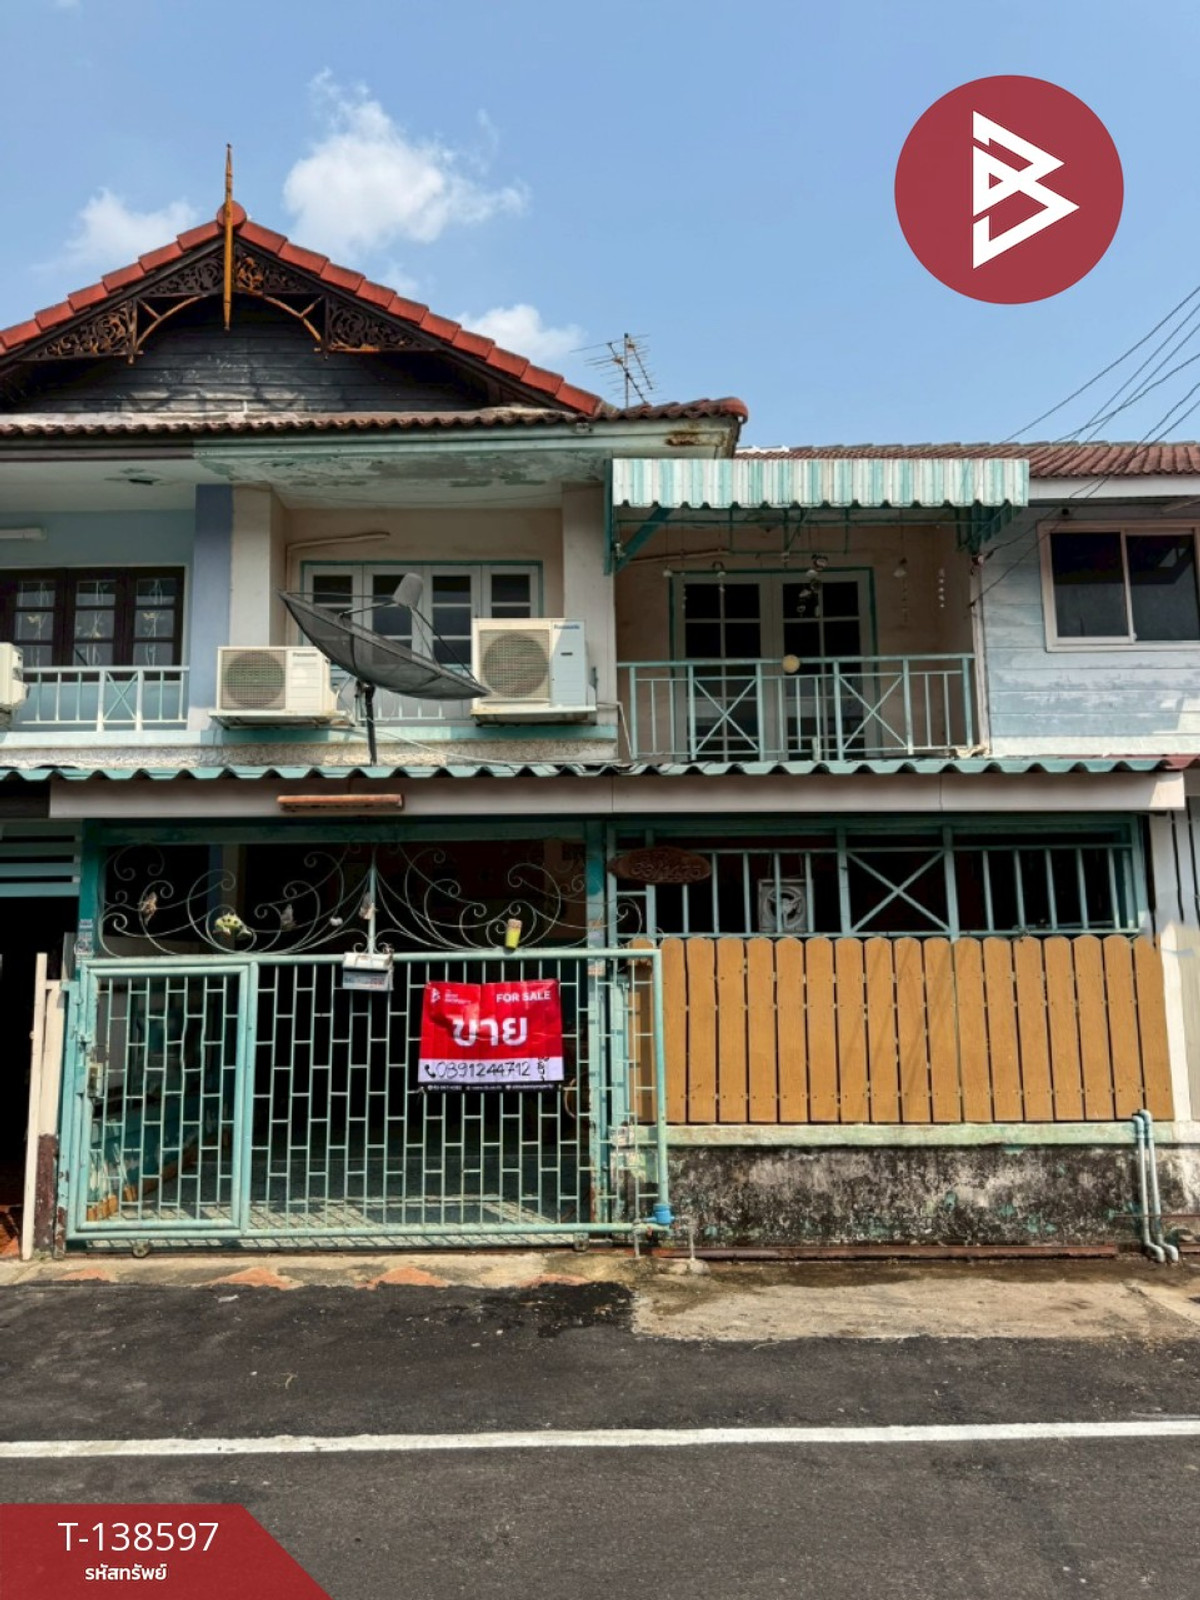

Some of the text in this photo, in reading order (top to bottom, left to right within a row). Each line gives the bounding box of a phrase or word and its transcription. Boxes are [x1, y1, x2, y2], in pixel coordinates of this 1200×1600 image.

[496, 990, 551, 1003] FOR SALE
[452, 1016, 528, 1047] ขาย
